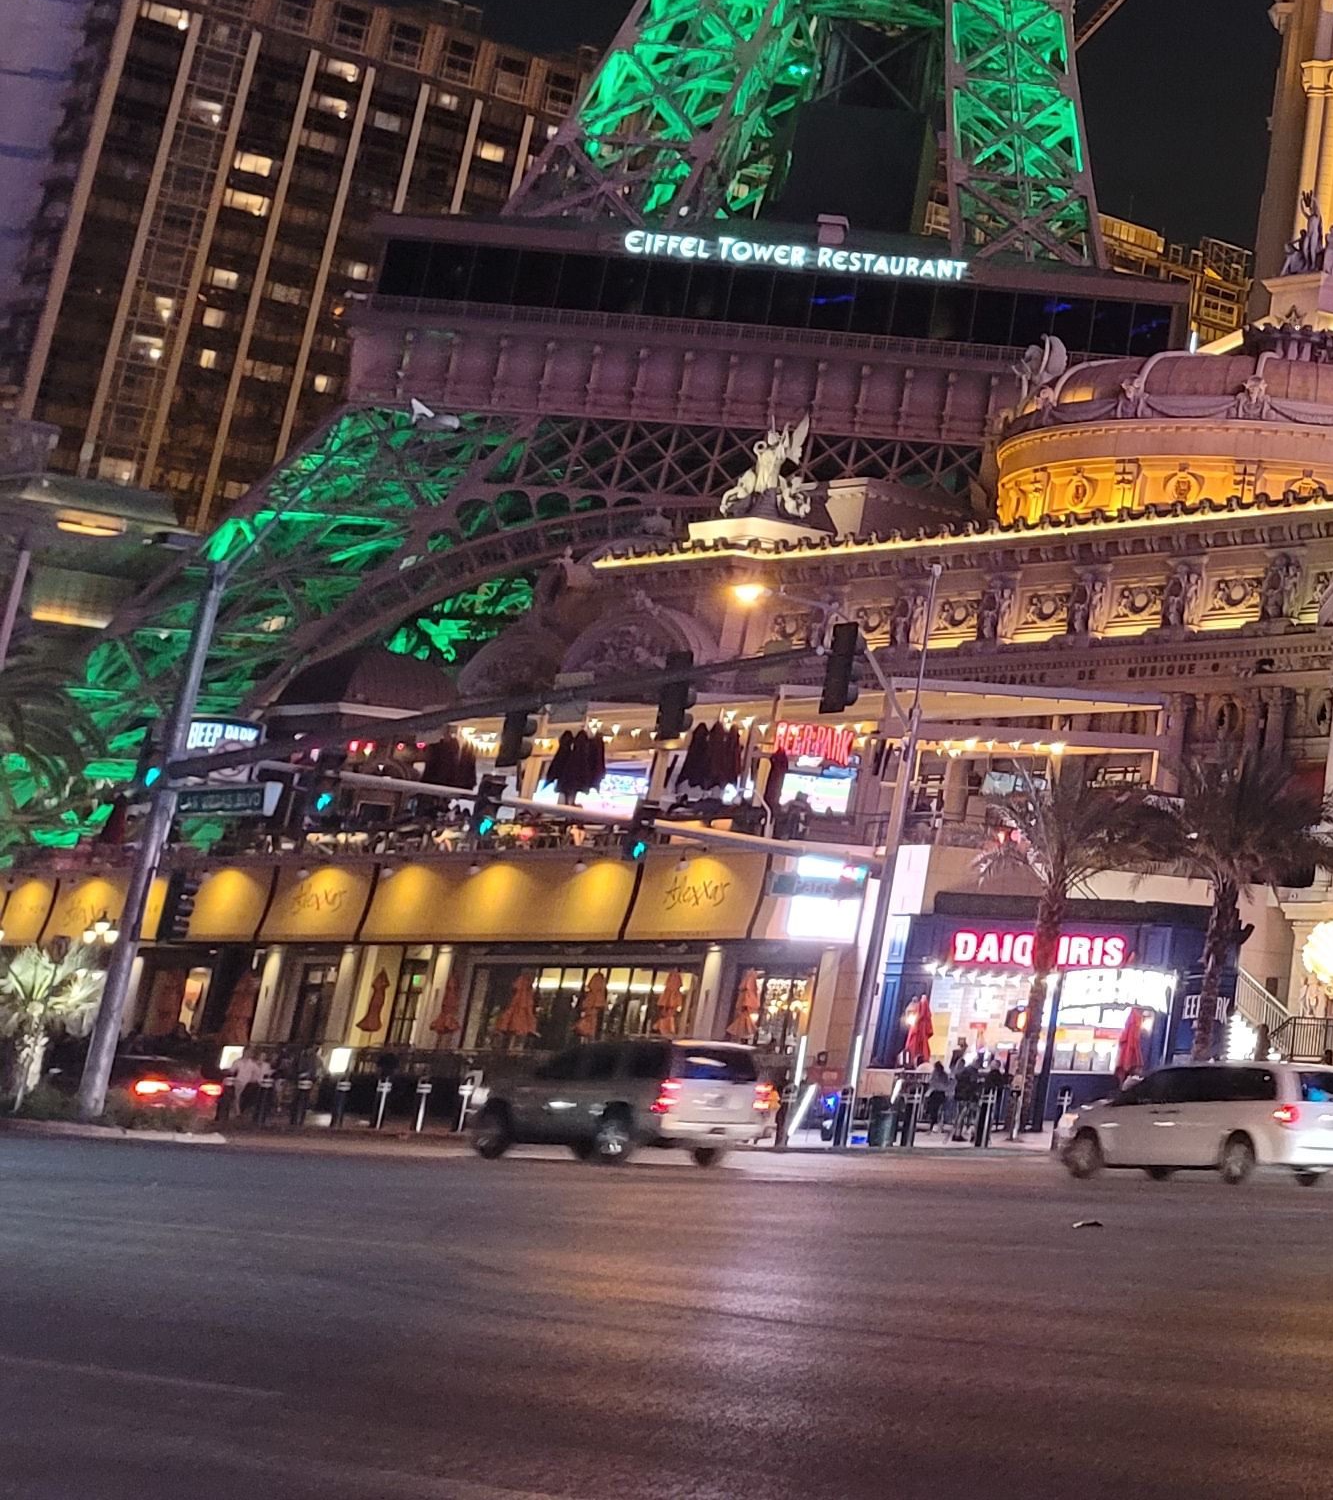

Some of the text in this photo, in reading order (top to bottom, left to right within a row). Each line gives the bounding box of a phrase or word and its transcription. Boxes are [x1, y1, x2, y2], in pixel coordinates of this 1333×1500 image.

[624, 229, 968, 280] EIFFEL TOWER RESTAURANT
[1077, 669, 1096, 680] DE
[1126, 663, 1197, 678] MUSIQUE
[773, 721, 855, 767] BEER PARK
[793, 877, 834, 897] Paris
[954, 932, 1126, 967] DAIQIRIS
